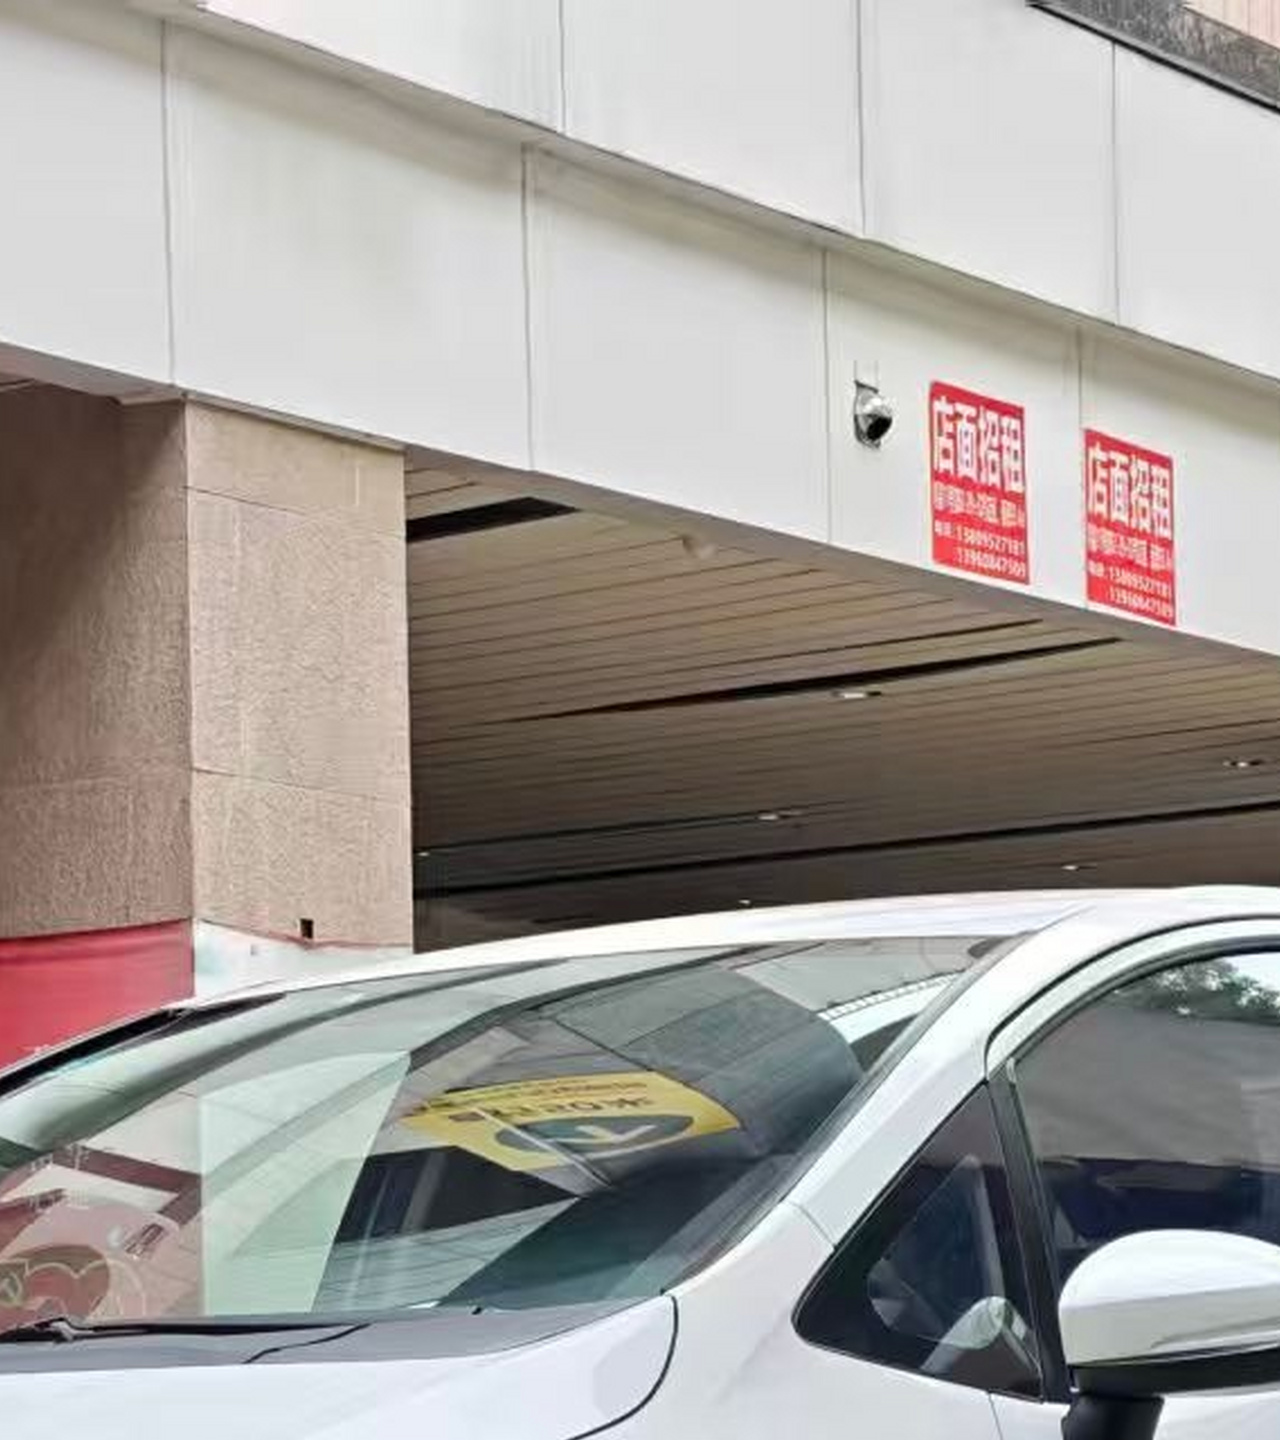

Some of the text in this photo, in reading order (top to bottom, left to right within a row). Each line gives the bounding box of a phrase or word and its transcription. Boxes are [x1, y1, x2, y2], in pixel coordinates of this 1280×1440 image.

[933, 395, 1025, 493] 店面招租
[1087, 442, 1172, 539] 店面招租
